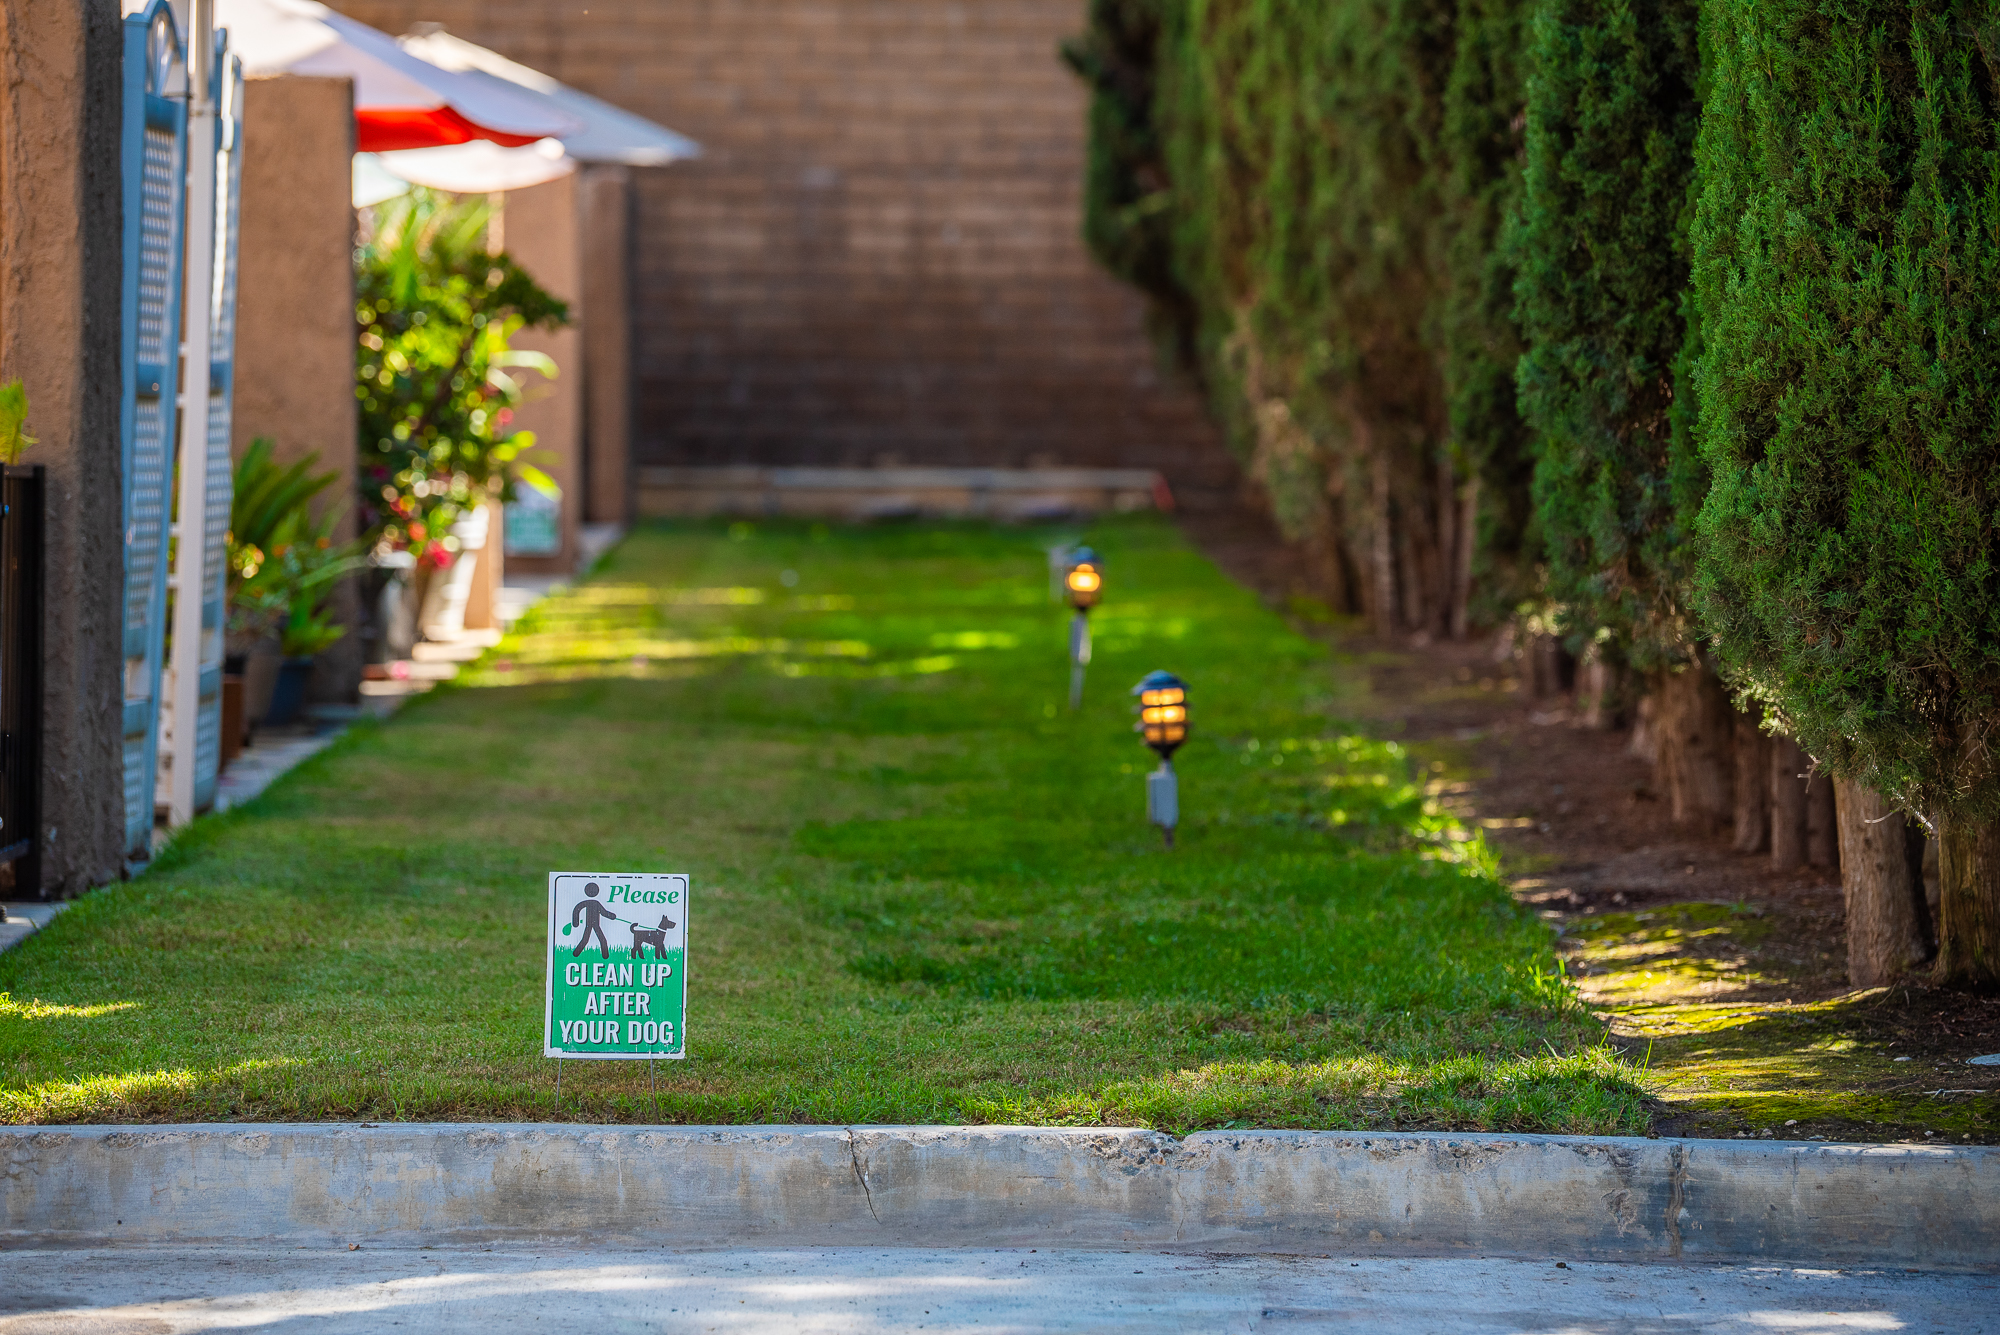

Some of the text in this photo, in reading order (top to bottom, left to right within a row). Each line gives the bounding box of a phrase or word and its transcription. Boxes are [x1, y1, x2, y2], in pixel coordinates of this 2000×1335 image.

[607, 884, 679, 904] Please
[565, 962, 672, 988] CLEAN UP
[584, 991, 651, 1016] AFTER
[559, 1020, 674, 1045] YOUR DOG
